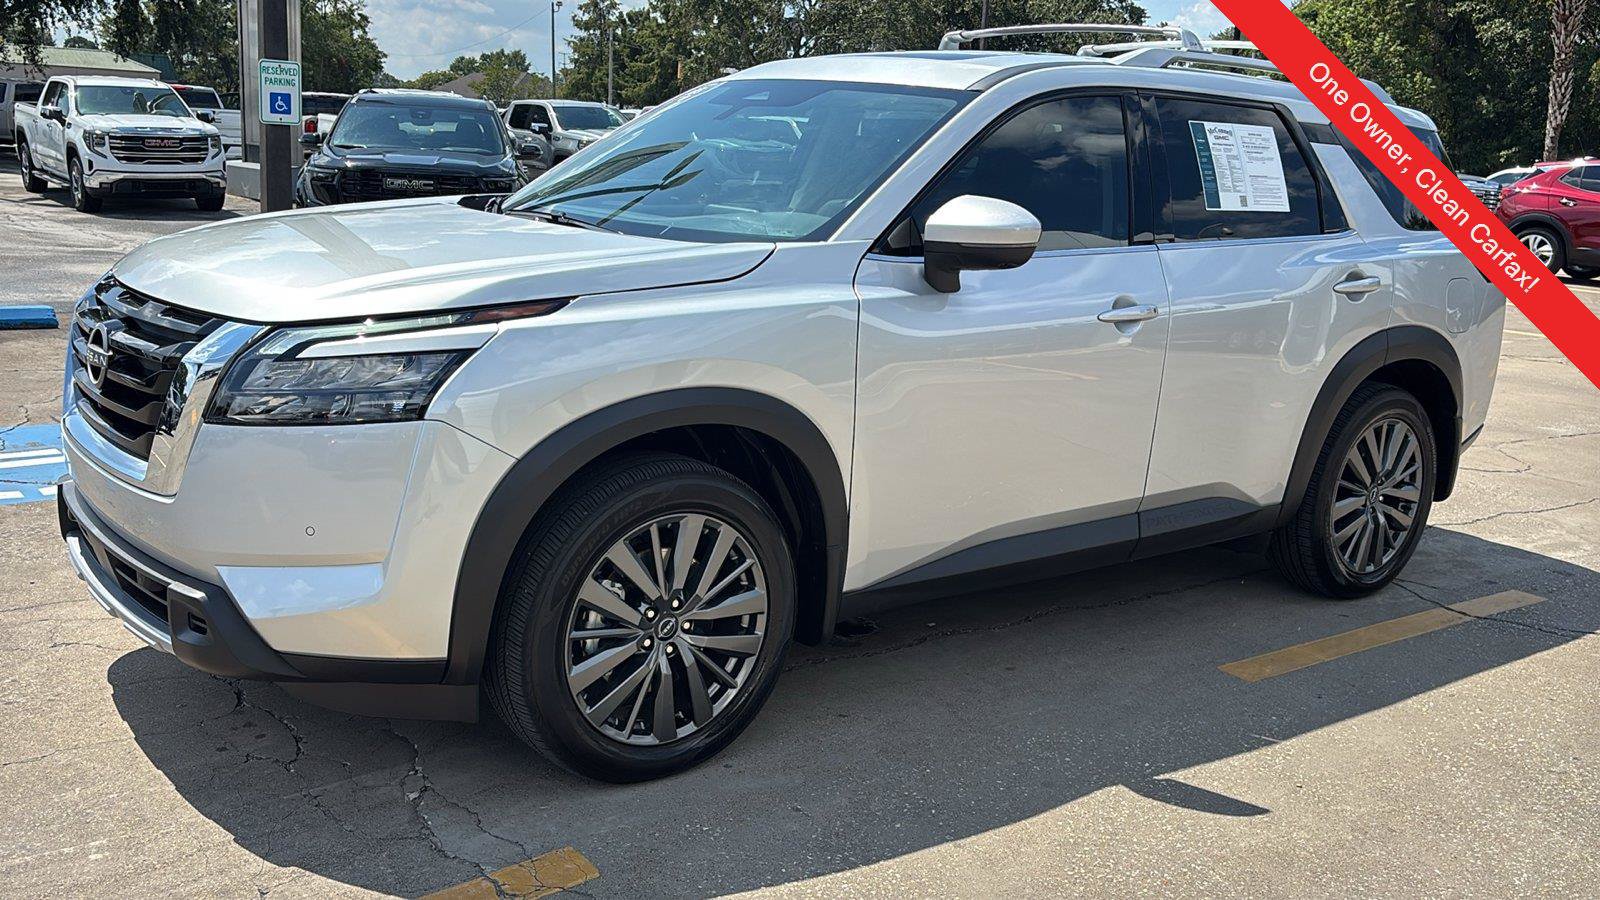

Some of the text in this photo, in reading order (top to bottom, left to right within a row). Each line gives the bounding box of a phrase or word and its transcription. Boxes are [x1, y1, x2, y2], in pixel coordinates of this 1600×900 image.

[261, 65, 298, 77] RESERVED
[264, 77, 296, 87] PARKING
[144, 138, 180, 147] GMC
[383, 178, 434, 190] GMC
